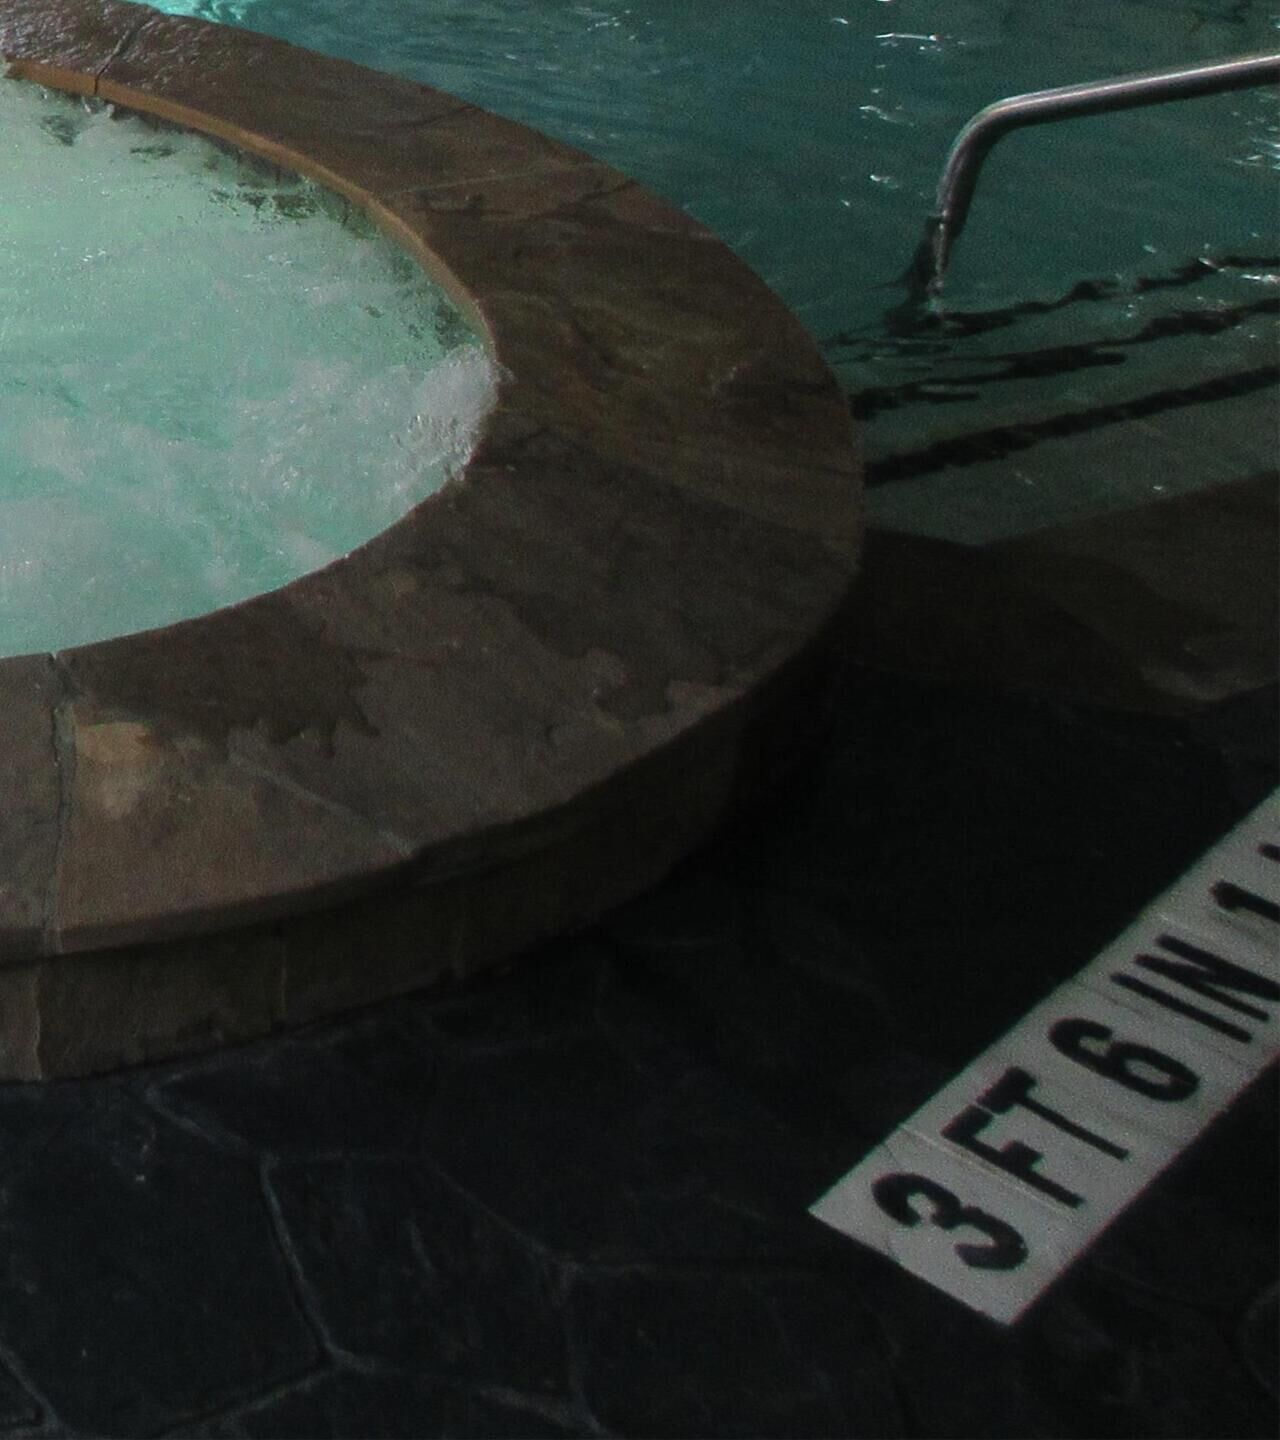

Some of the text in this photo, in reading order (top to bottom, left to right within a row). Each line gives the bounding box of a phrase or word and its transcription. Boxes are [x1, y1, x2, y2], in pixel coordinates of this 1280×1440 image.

[1110, 934, 1280, 1044] IN
[1048, 1016, 1201, 1103] 6
[941, 1065, 1131, 1209] FT
[870, 1171, 1029, 1272] 3
